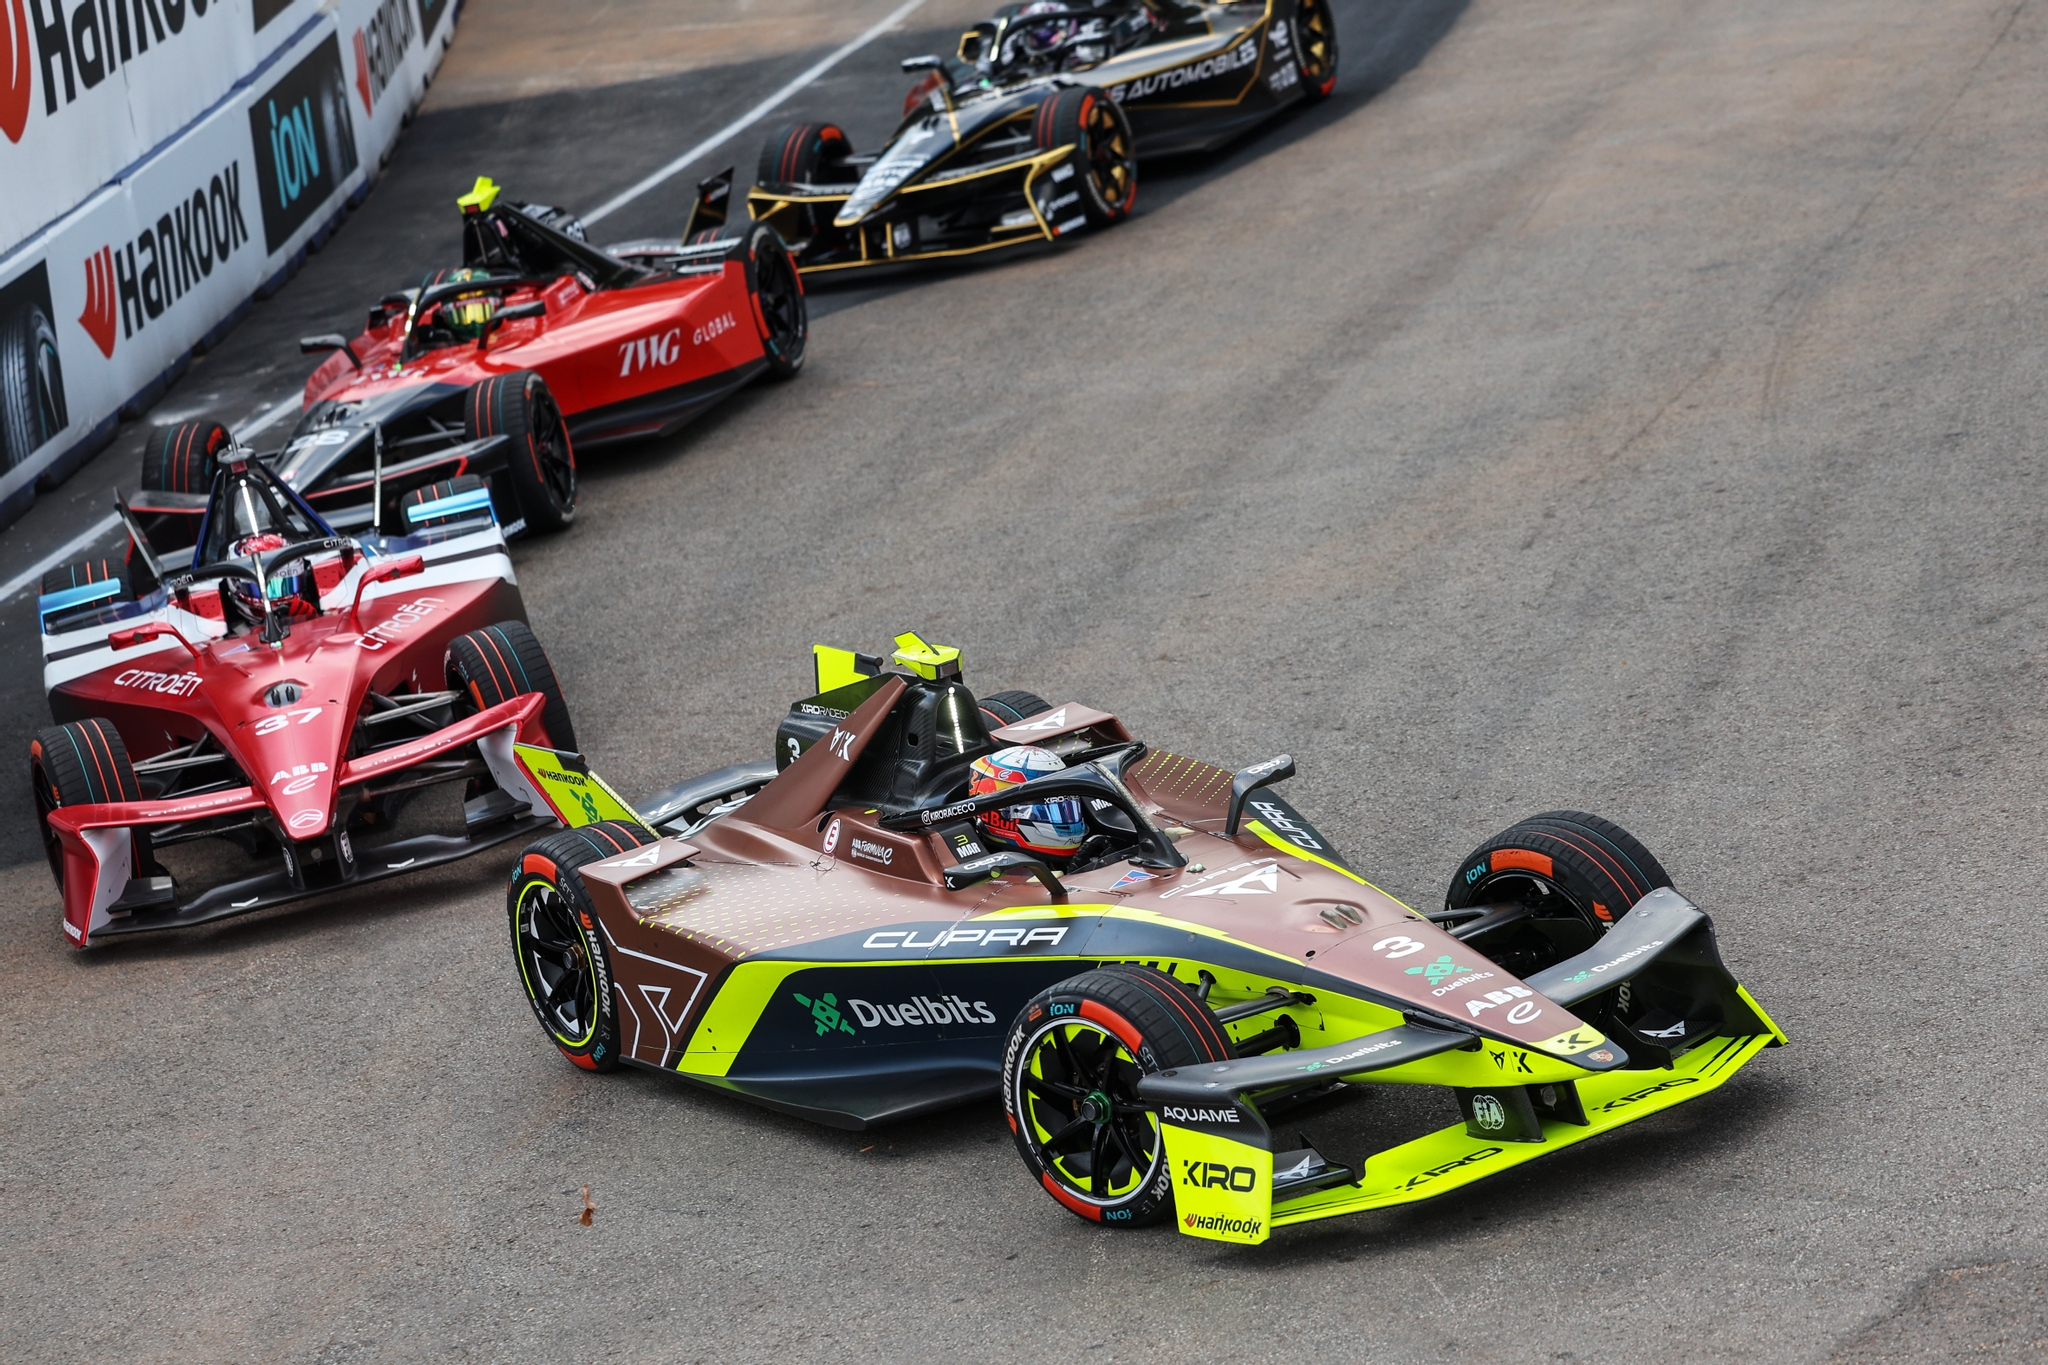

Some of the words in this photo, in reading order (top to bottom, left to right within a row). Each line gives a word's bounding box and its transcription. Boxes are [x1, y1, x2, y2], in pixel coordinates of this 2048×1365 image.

[1127, 38, 1257, 100] AUTOMOBILES
[618, 327, 680, 378] TWG
[693, 311, 736, 345] GLOBAL
[255, 707, 323, 736] 37
[270, 762, 329, 785] ABB
[1249, 801, 1323, 850] CUPRA
[956, 842, 981, 858] MAR
[1159, 857, 1278, 899] CUPRA
[862, 926, 1069, 949] CUPRA
[1372, 935, 1426, 959] 3
[1591, 939, 1664, 973] Duelbits
[1432, 971, 1495, 998] Duelbits
[847, 995, 996, 1028] Duelbits
[1465, 985, 1534, 1018] ABB
[1325, 1039, 1402, 1064] Duelbits
[1591, 1077, 1699, 1113] KIRO
[1183, 1159, 1256, 1193] KIRO
[1395, 1147, 1504, 1192] KIRO
